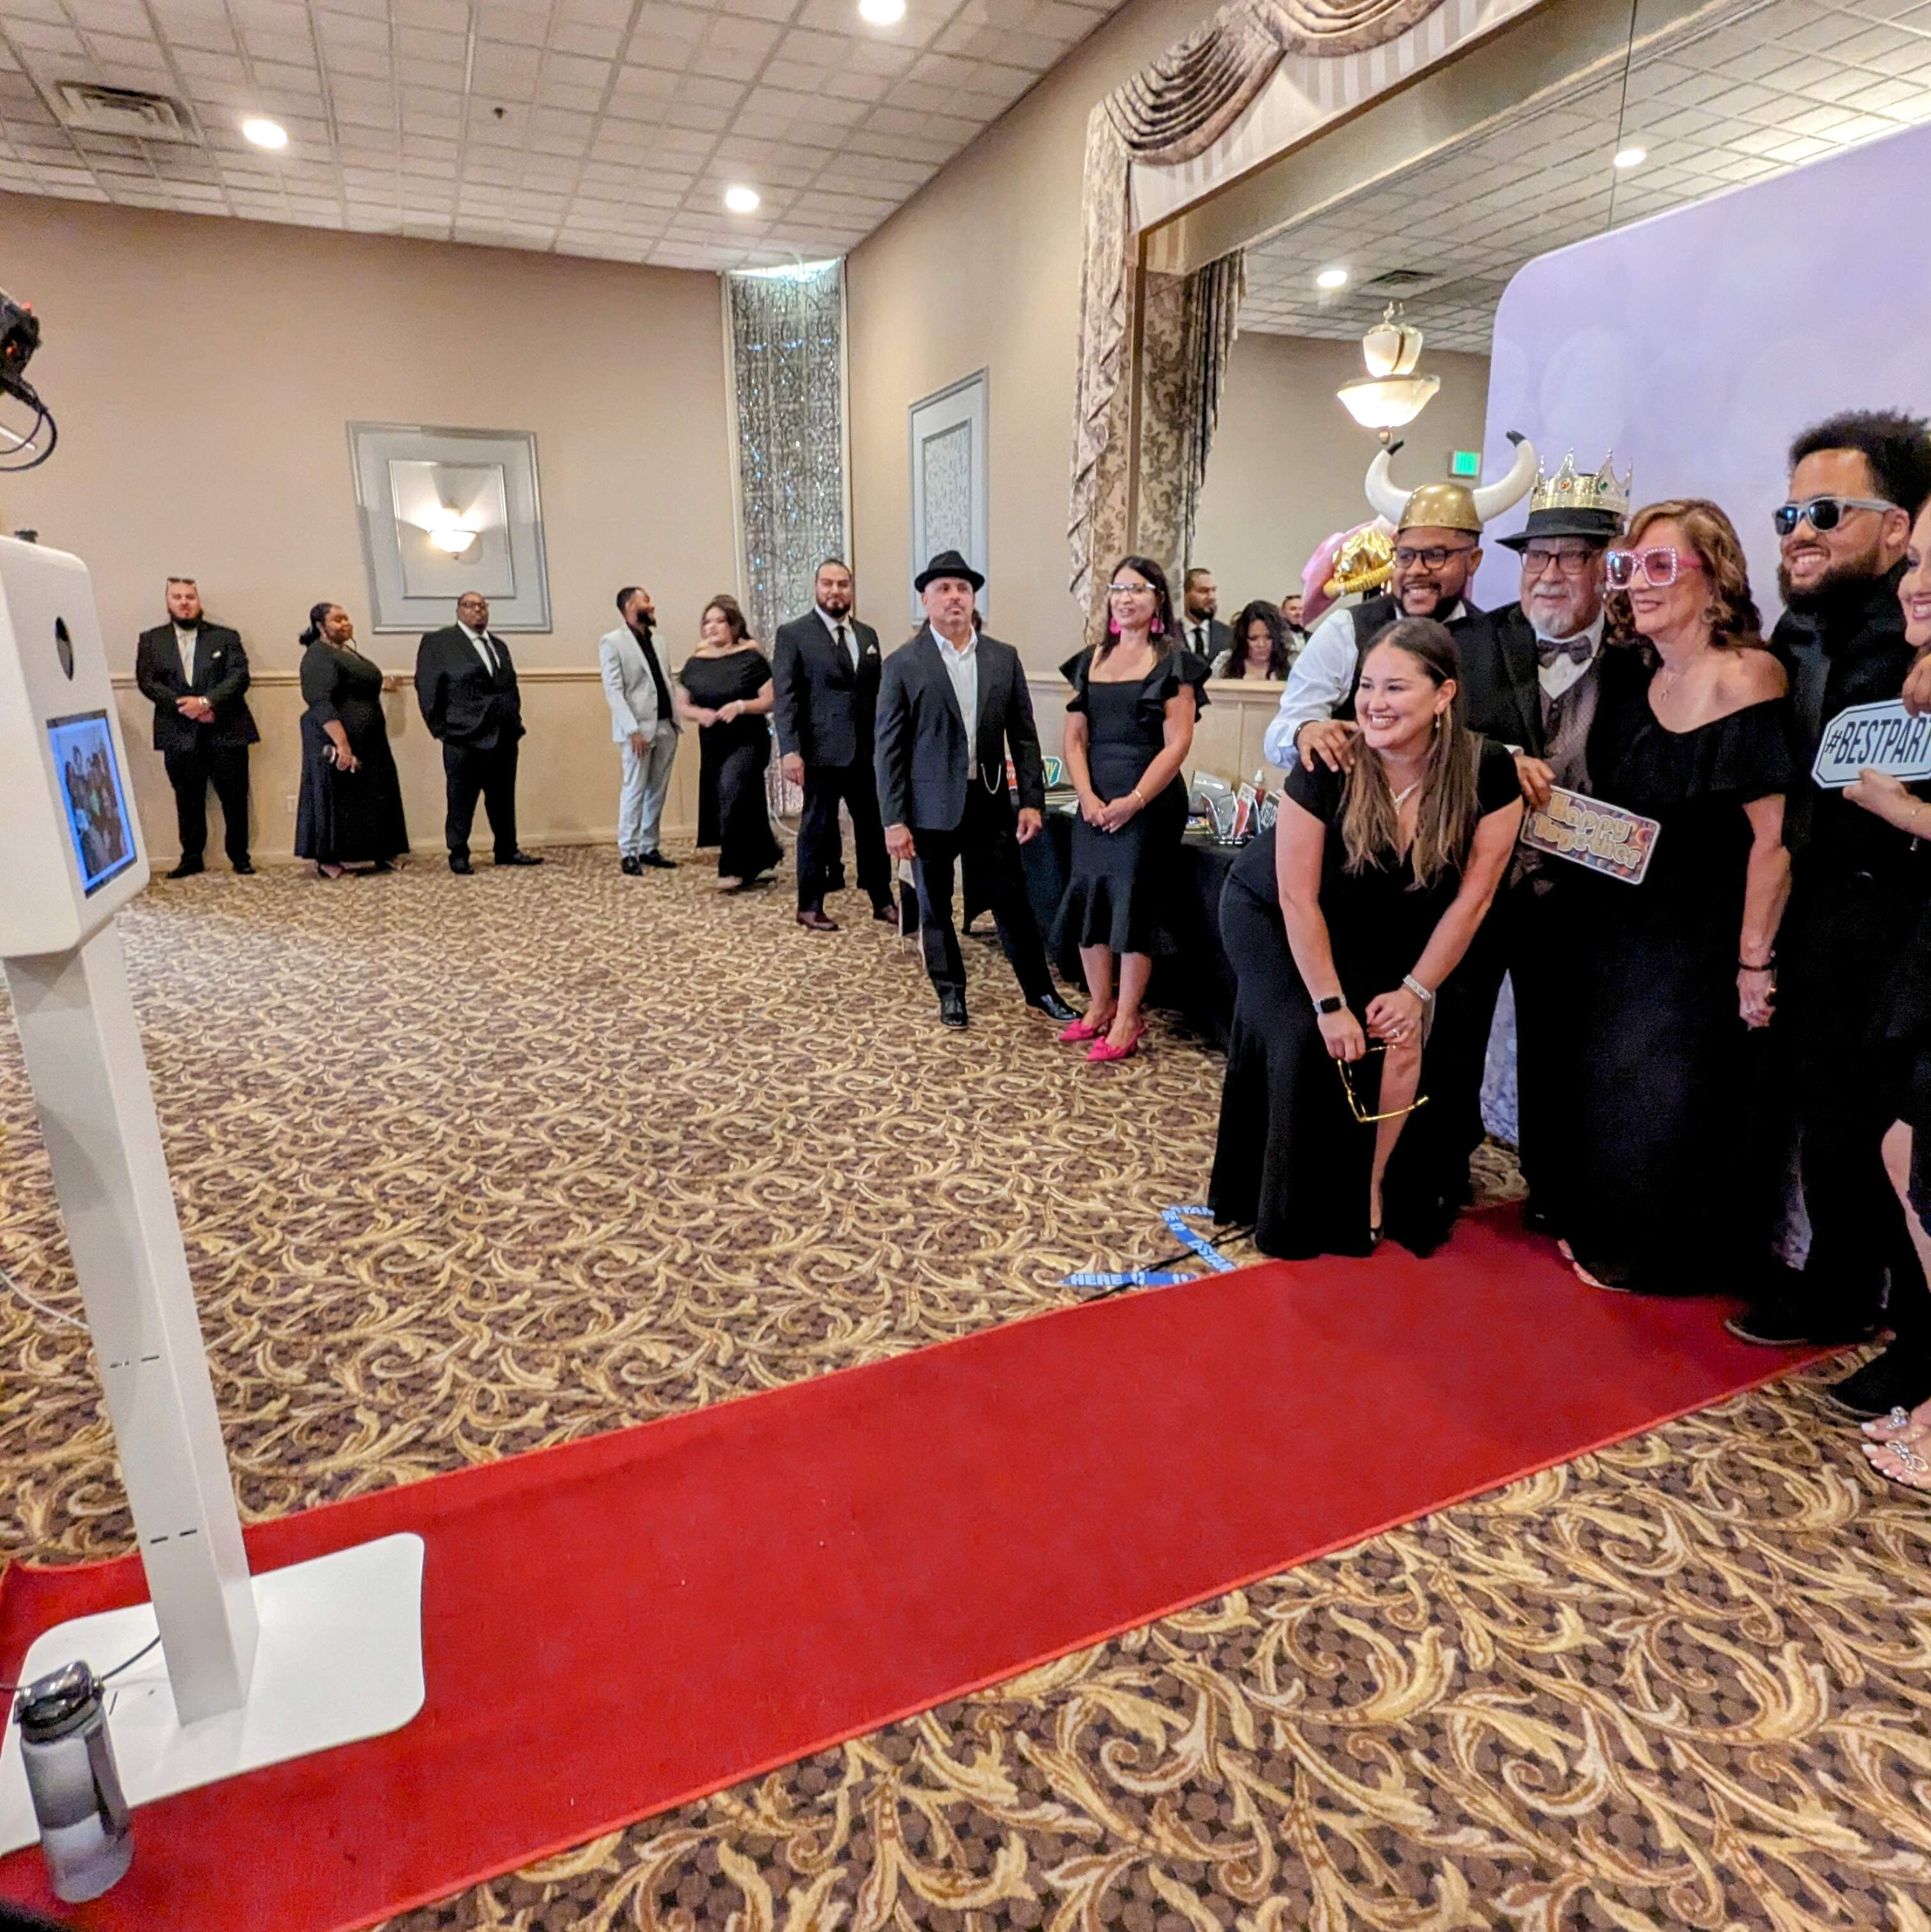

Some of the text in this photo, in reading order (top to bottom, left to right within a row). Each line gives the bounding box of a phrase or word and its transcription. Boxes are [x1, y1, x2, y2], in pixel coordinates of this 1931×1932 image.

[1534, 814, 1640, 869] Together
[1548, 793, 1630, 842] Happy
[1071, 1274, 1123, 1285] HERE
